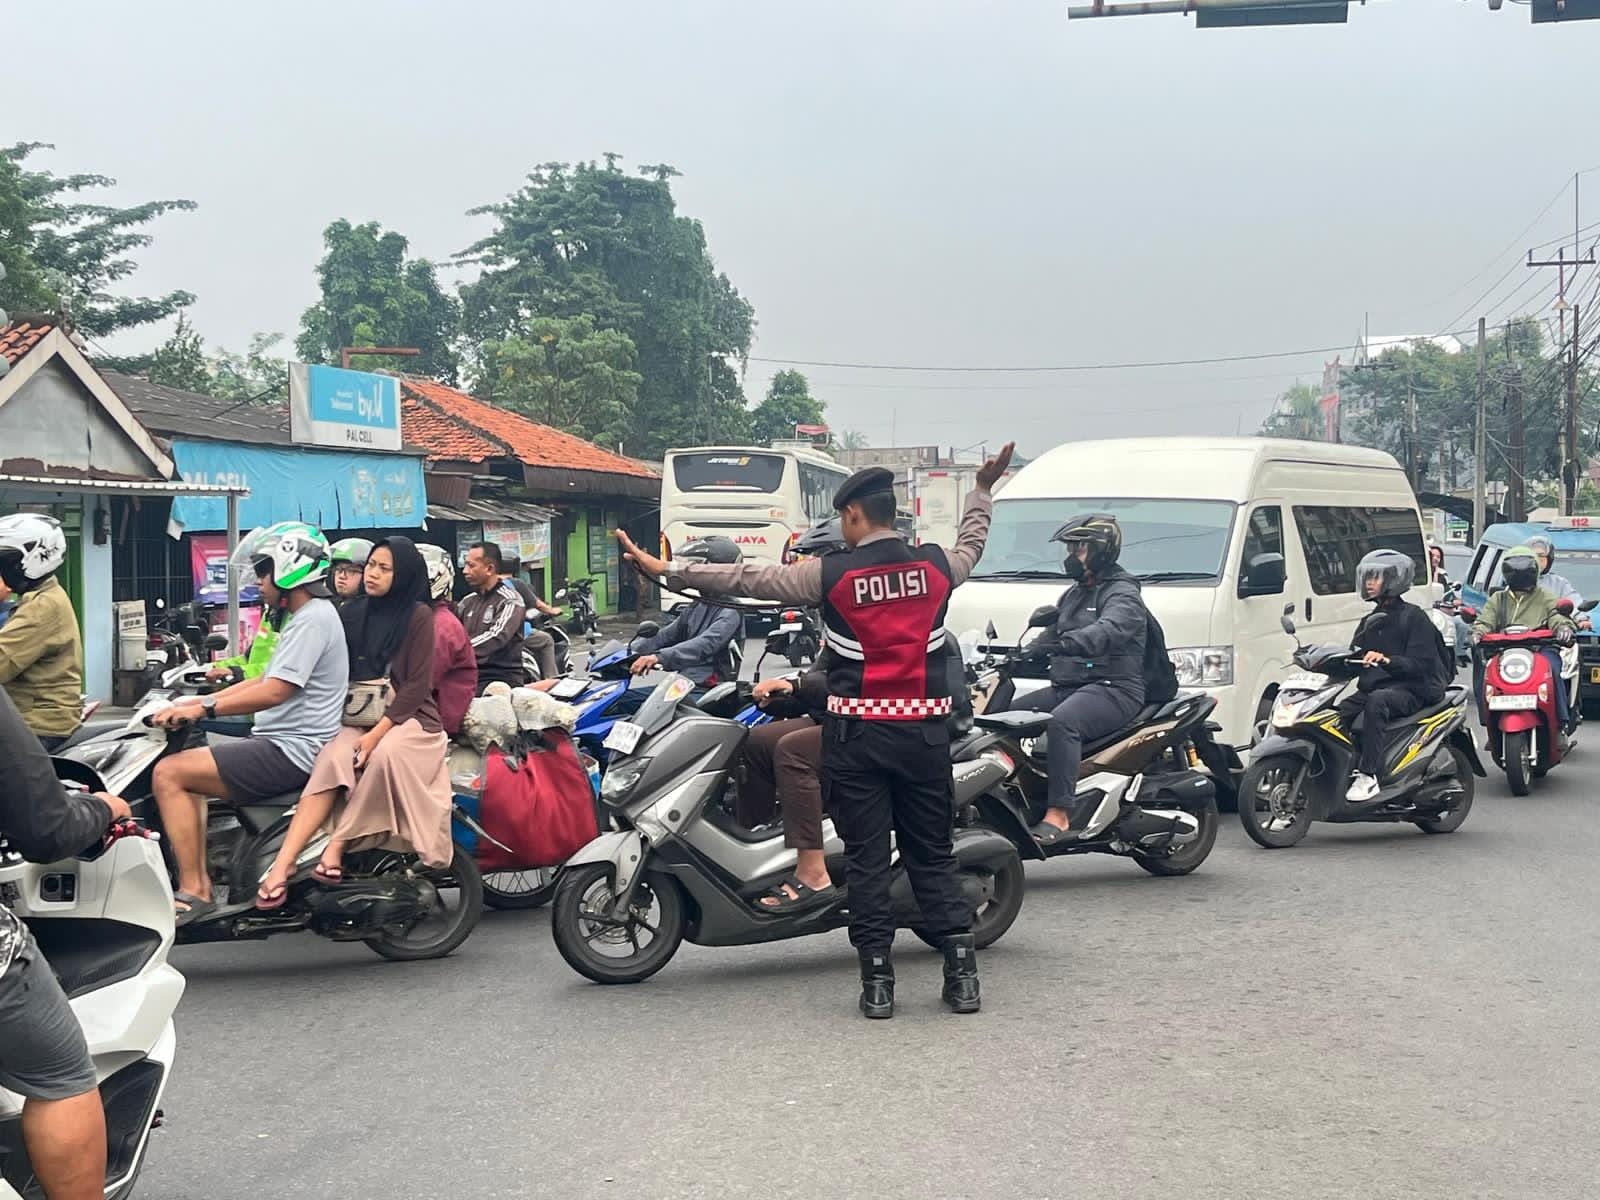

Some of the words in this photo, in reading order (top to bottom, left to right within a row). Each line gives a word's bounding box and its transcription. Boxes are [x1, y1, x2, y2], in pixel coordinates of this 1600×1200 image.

[346, 428, 358, 443] PAL
[359, 431, 373, 444] CELL
[1571, 517, 1589, 527] 112
[735, 535, 767, 544] JAYA
[854, 569, 928, 604] POLISI
